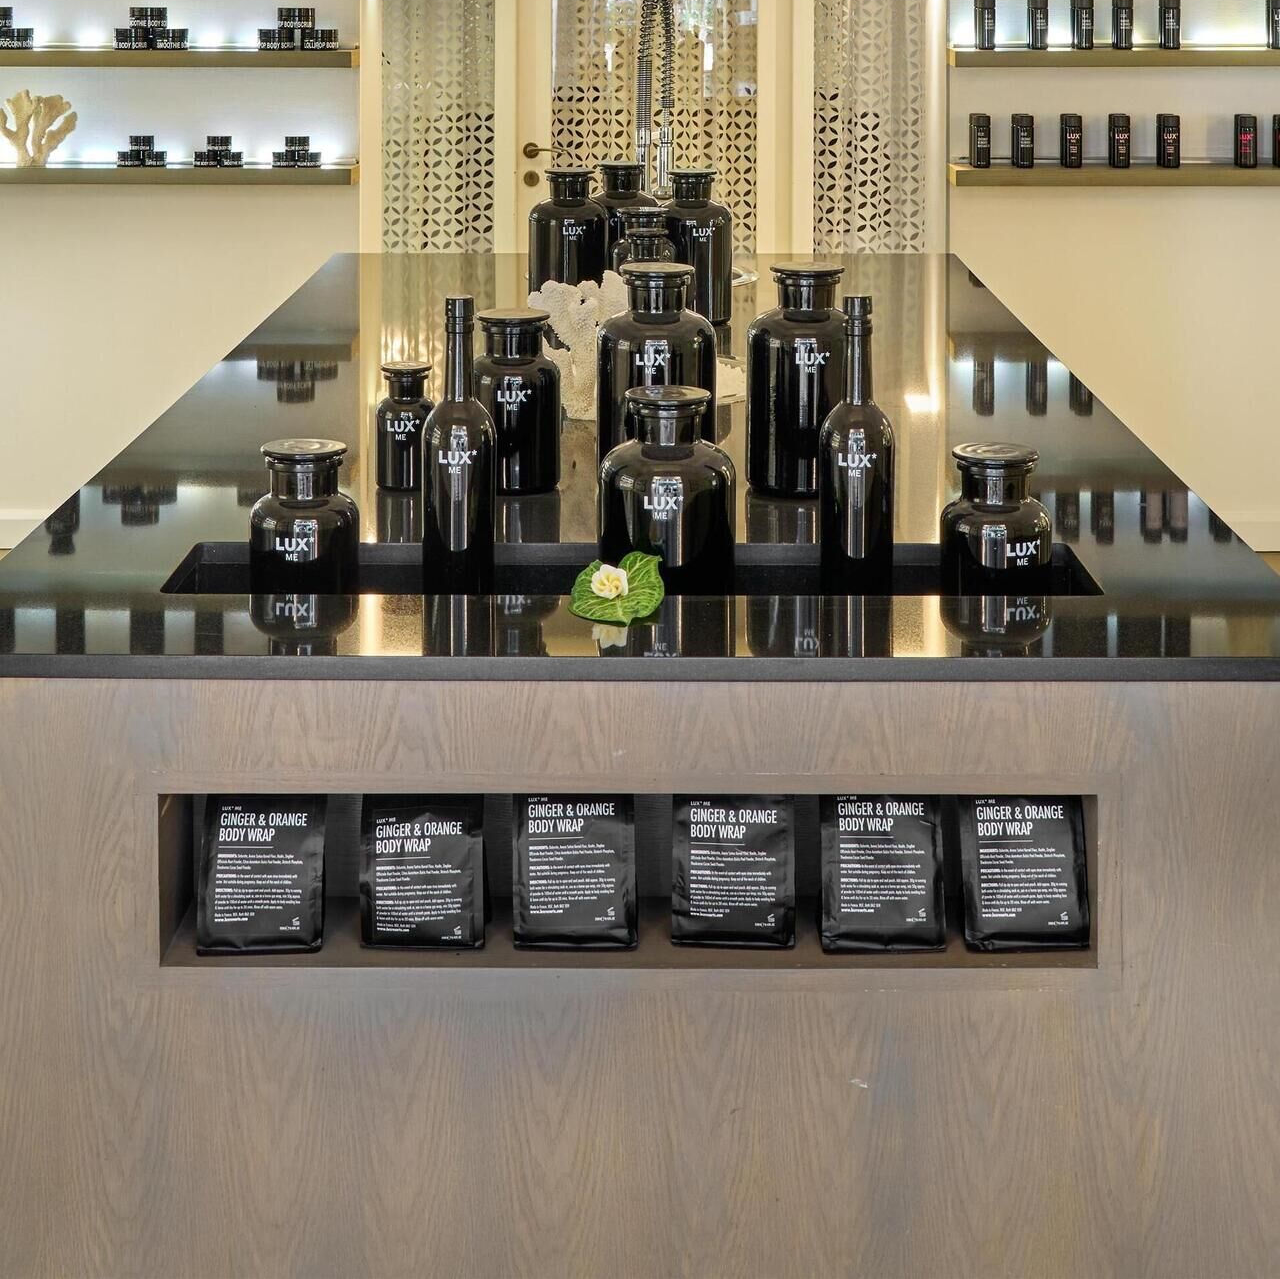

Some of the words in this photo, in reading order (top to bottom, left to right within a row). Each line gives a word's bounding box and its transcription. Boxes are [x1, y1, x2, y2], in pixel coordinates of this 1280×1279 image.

[506, 403, 518, 411] ME
[448, 466, 461, 474] ME
[653, 512, 668, 520] ME
[285, 553, 299, 562] ME
[1016, 558, 1029, 566] ME
[528, 803, 564, 817] GINGER
[566, 804, 574, 817] &
[576, 803, 615, 816] ORANGE
[690, 808, 726, 823] GINGER
[728, 810, 737, 823] &
[738, 809, 777, 824] ORANGE
[838, 802, 873, 816] GINGER
[875, 803, 884, 816] &
[886, 802, 924, 816] ORANGE
[976, 806, 1013, 820] GINGER
[1014, 806, 1023, 819] &
[1025, 805, 1064, 819] ORANGE
[220, 813, 256, 826] GINGER
[258, 814, 266, 826] &
[268, 813, 308, 826] ORANGE
[528, 819, 555, 833] BODY
[556, 819, 584, 832] WRAP
[839, 817, 866, 831] BODY
[866, 818, 894, 832] WRAP
[219, 828, 246, 841] BODY
[247, 828, 275, 841] WRAP
[376, 823, 411, 838] GINGER
[413, 824, 422, 836] &
[424, 822, 463, 835] ORANGE
[690, 824, 716, 838] BODY
[718, 825, 746, 839] WRAP
[977, 822, 1004, 836] BODY
[1005, 822, 1033, 836] WRAP
[376, 839, 402, 854] BODY
[403, 838, 431, 853] WRAP
